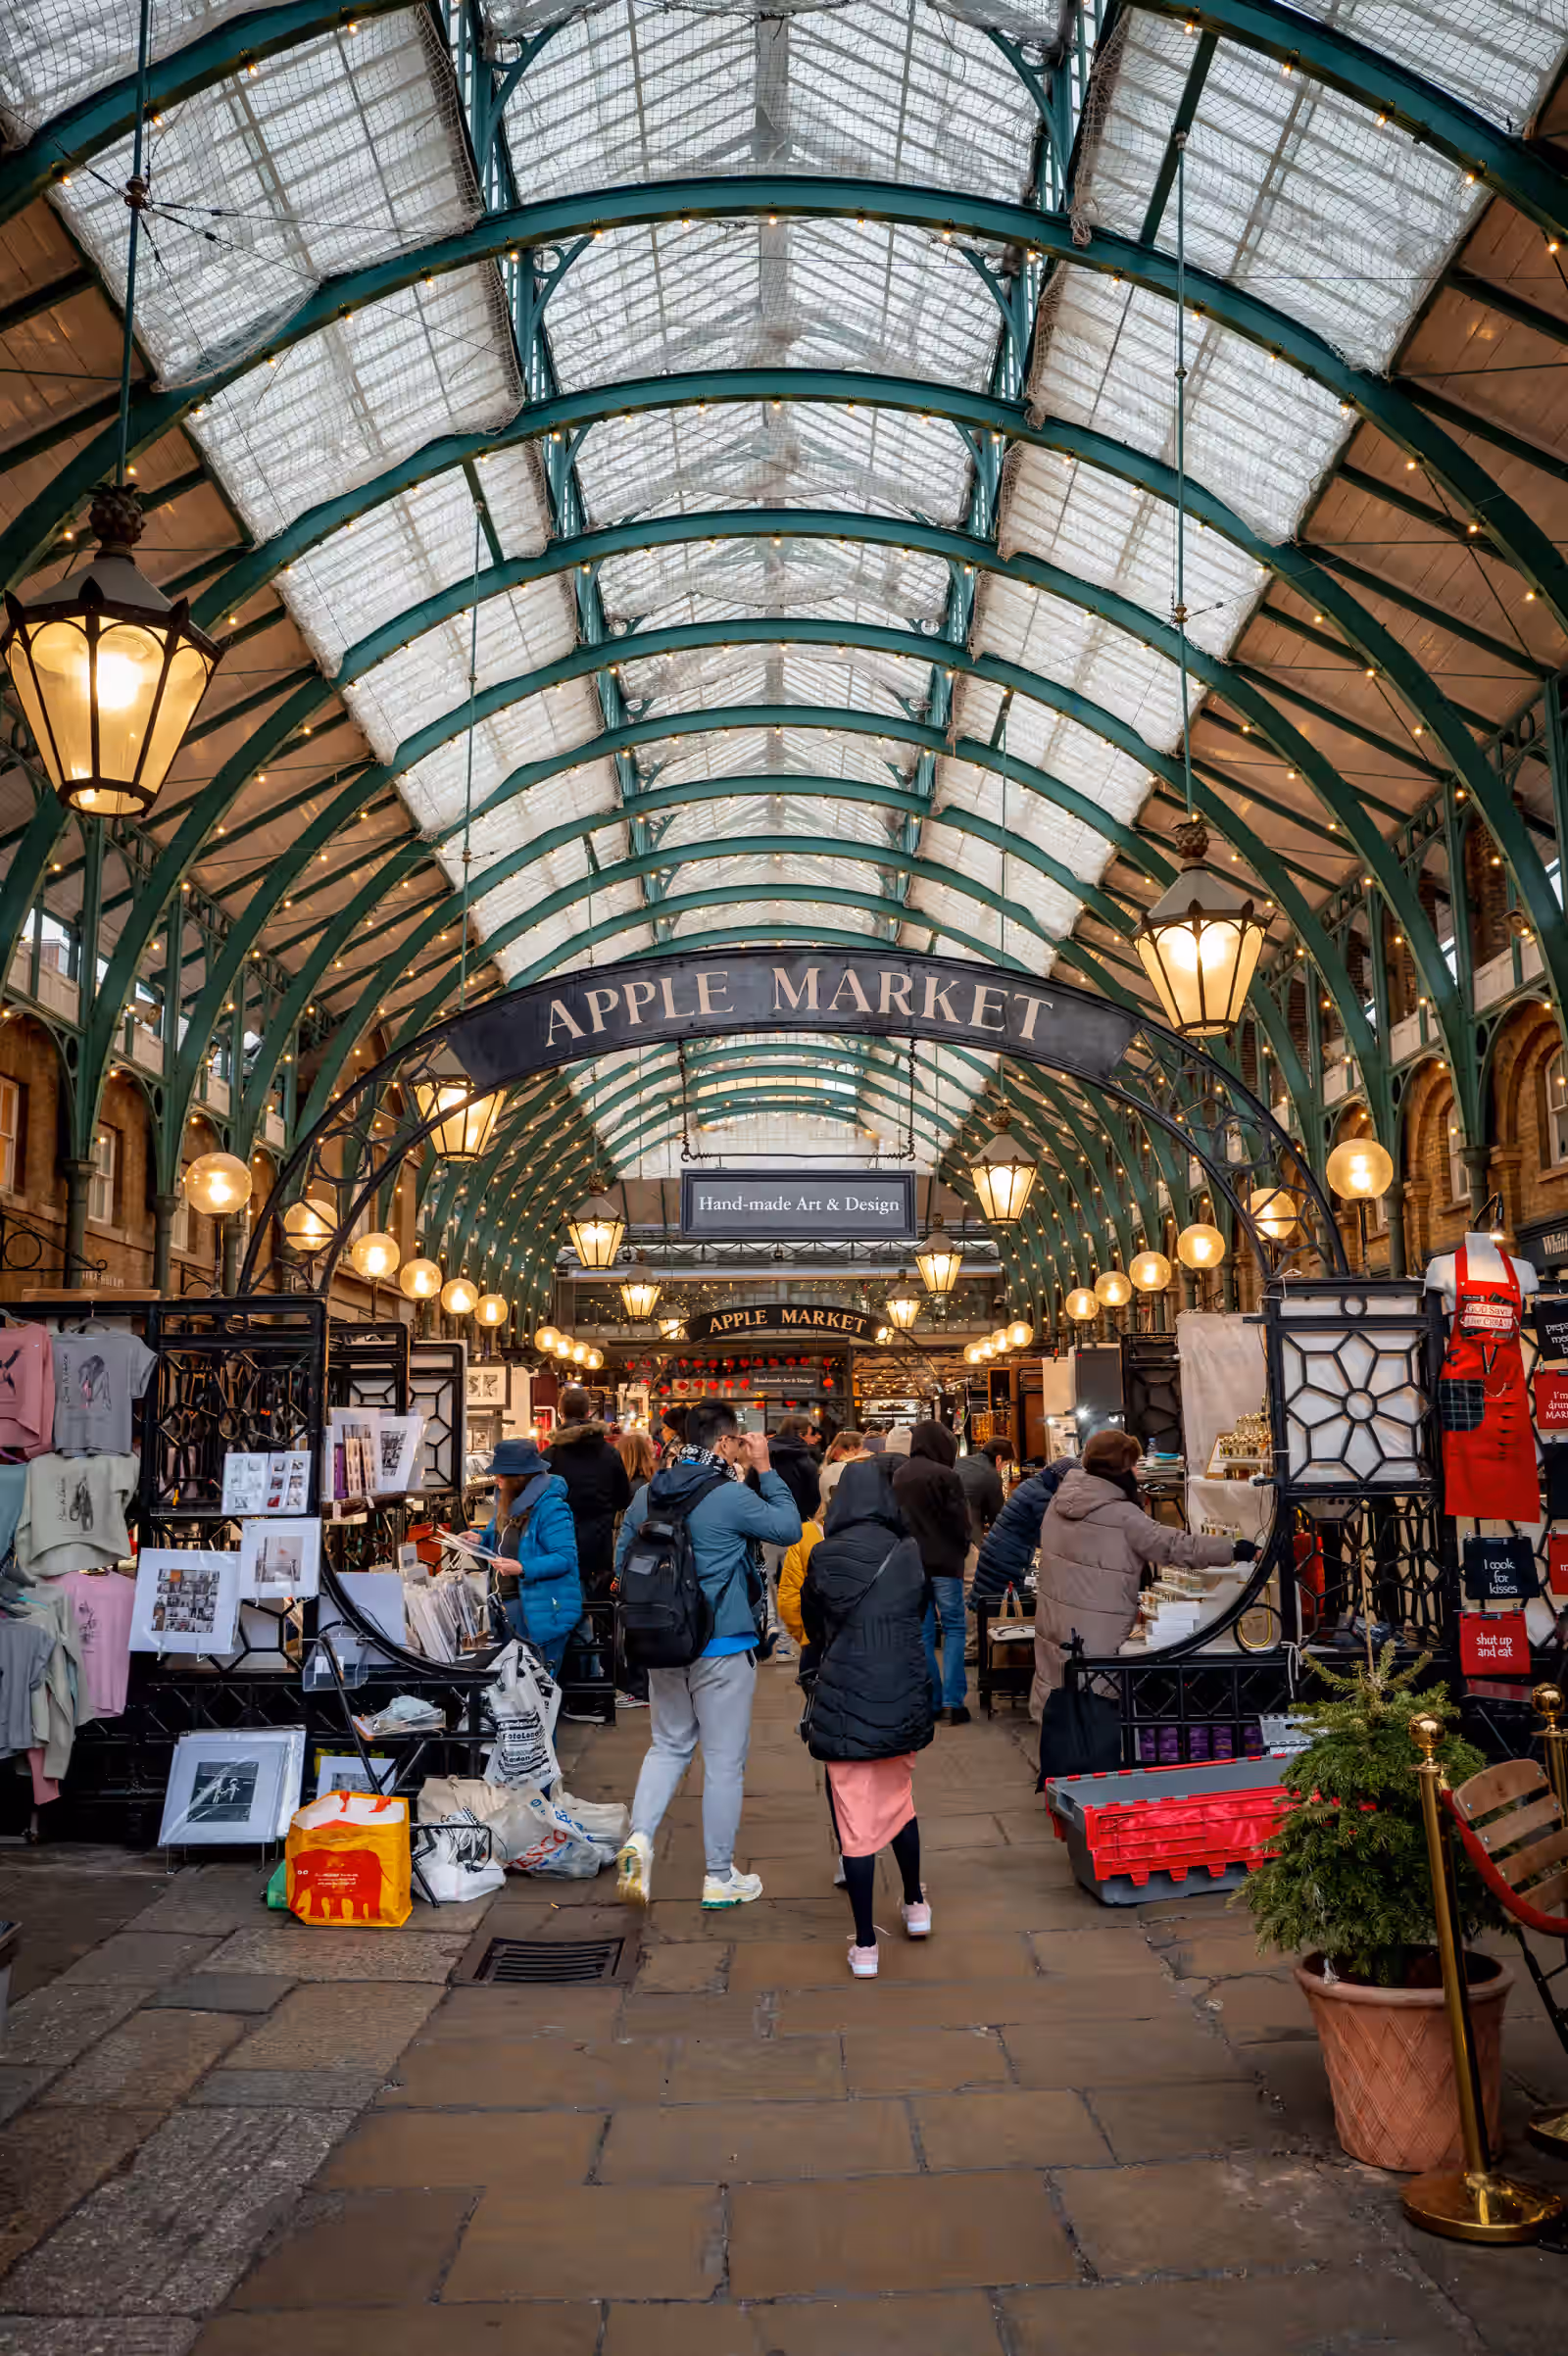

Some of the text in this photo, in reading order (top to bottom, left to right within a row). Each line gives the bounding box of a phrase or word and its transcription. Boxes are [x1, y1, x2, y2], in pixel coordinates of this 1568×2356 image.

[544, 966, 1054, 1048] APPLE MARKET
[699, 1196, 901, 1214] Hand-made Art & Design
[709, 1309, 867, 1334] APPLE MARKET
[1484, 1557, 1516, 1570] I cook
[1494, 1570, 1509, 1584] for
[1489, 1583, 1518, 1595] kisses
[1476, 1632, 1513, 1648] shut up
[1477, 1645, 1514, 1658] and eat
